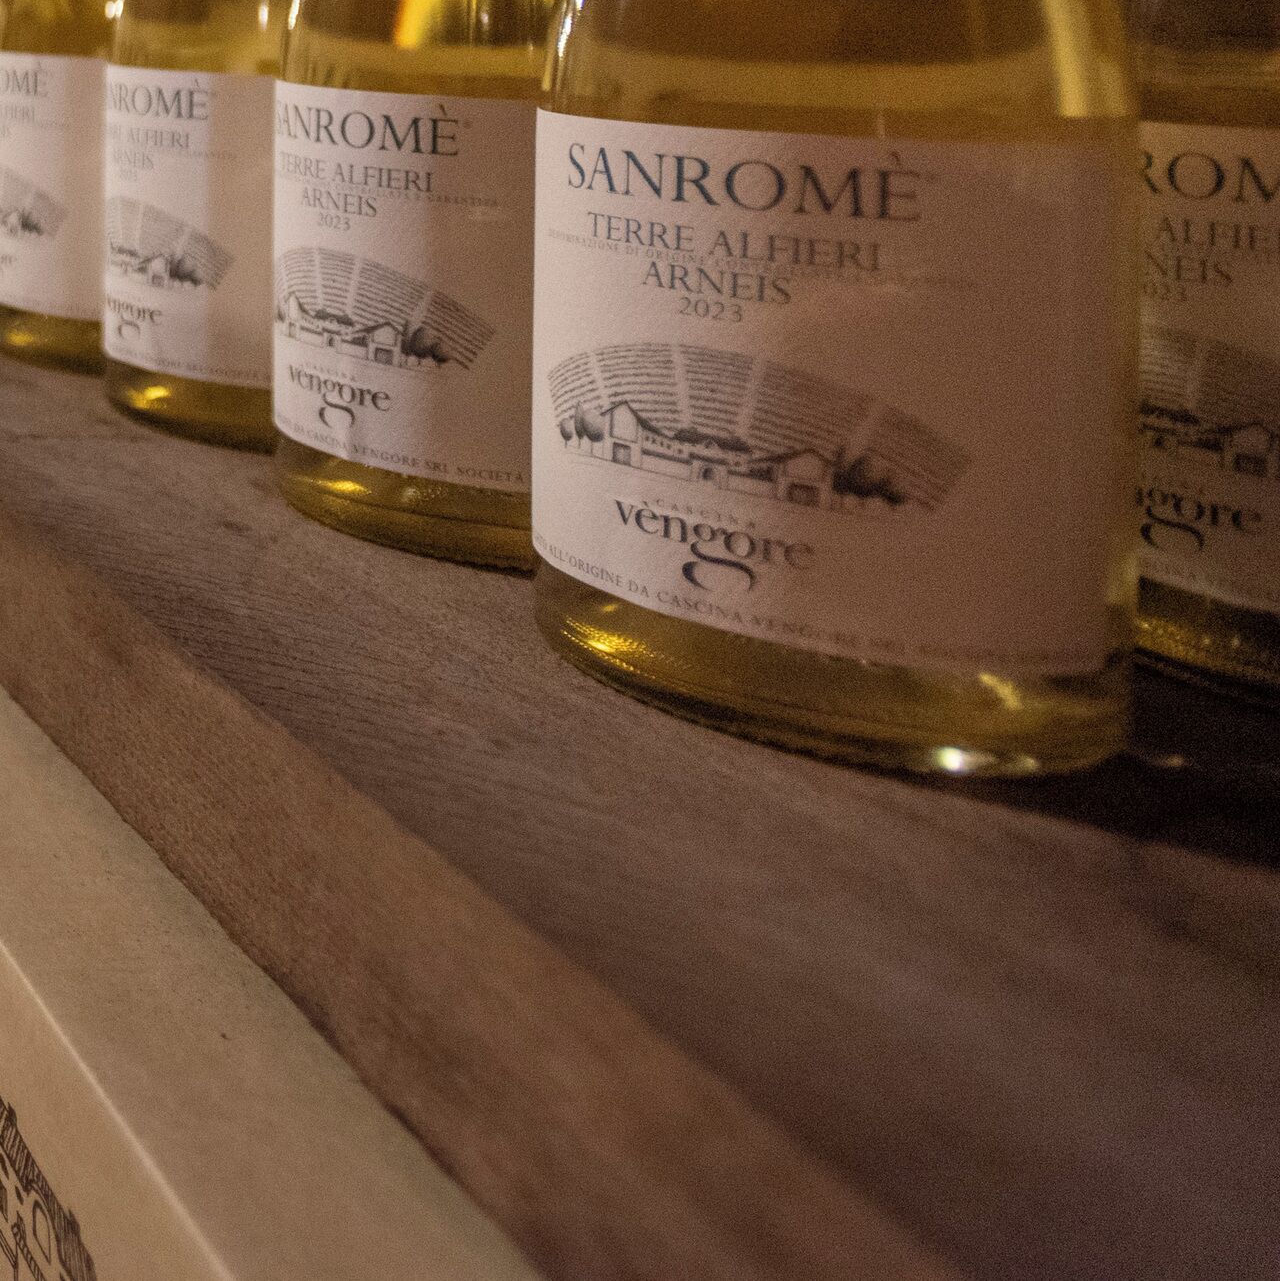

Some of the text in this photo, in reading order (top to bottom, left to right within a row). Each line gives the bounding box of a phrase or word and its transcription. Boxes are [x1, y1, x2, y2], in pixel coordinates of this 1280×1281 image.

[332, 162, 433, 193] ALFIERI
[568, 143, 921, 222] SANROMÈ
[301, 186, 378, 218] ARNEIS
[588, 212, 882, 273] TERRE ALFIERI
[1157, 218, 1280, 255] ALFIE
[643, 261, 791, 304] ARNEIS
[679, 297, 744, 323] 2023
[628, 580, 650, 598] DA
